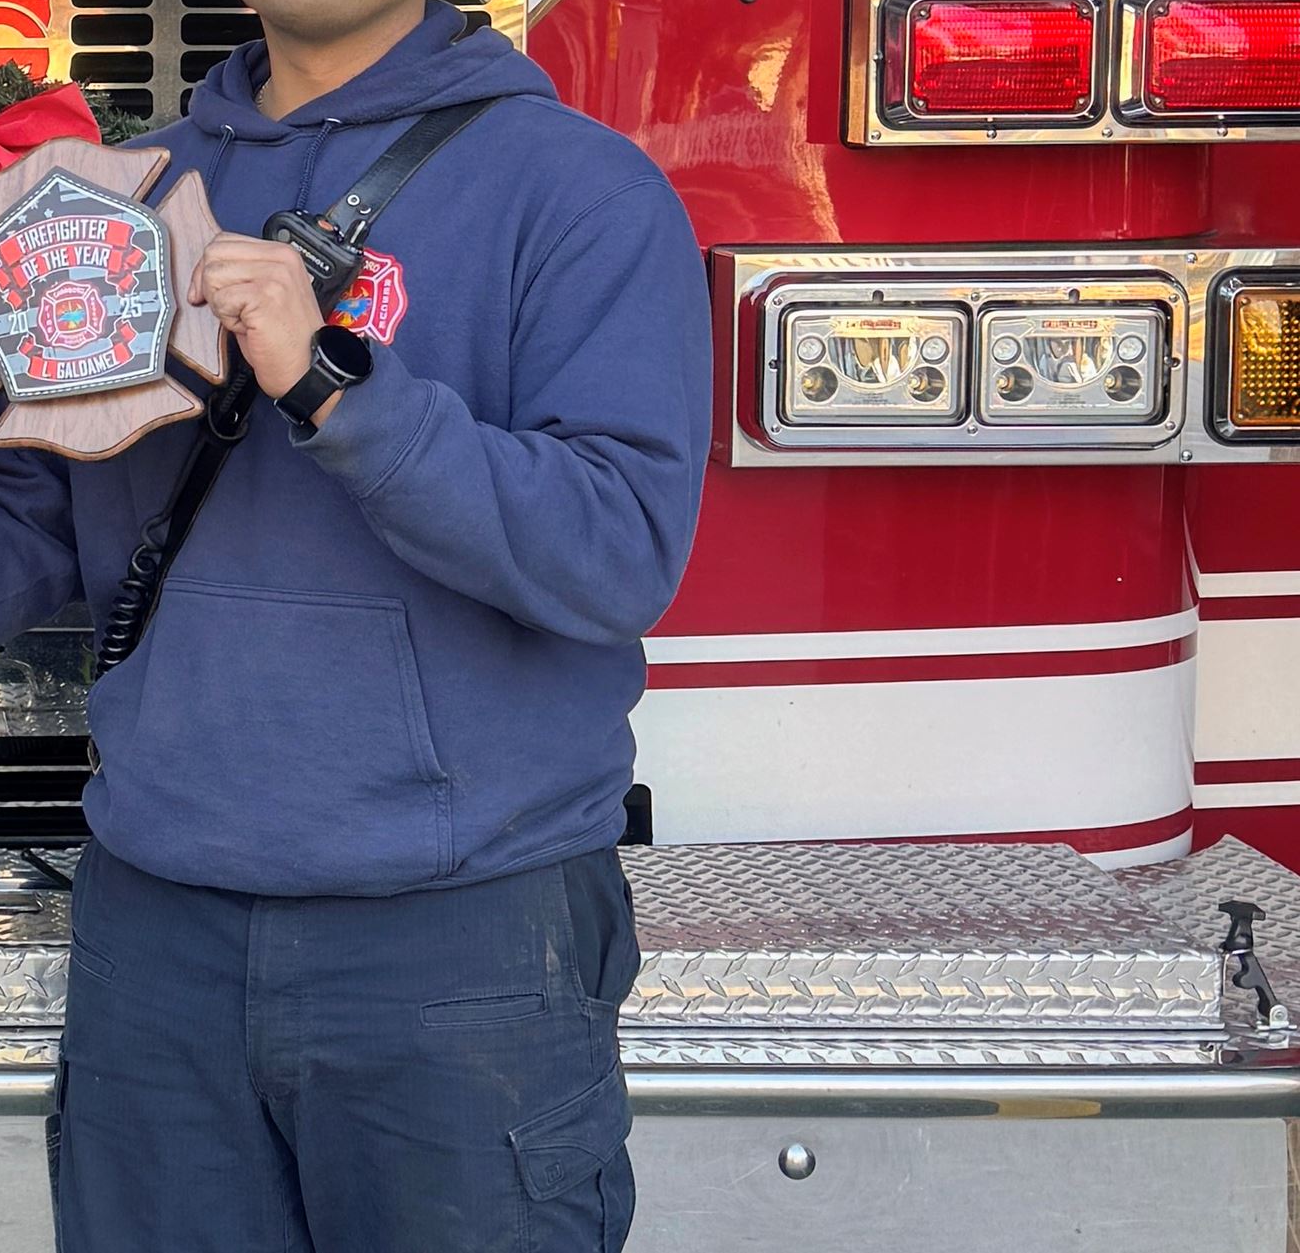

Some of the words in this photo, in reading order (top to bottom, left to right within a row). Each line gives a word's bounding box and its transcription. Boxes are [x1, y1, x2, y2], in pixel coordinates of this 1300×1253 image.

[16, 219, 108, 253] FIREFIGHTER
[20, 258, 39, 281] OF
[41, 248, 70, 271] THE
[73, 246, 111, 268] YEAR
[8, 311, 29, 334] 20
[119, 295, 143, 319] 25
[42, 361, 51, 378] L
[57, 349, 120, 379] GALDAMEZ
